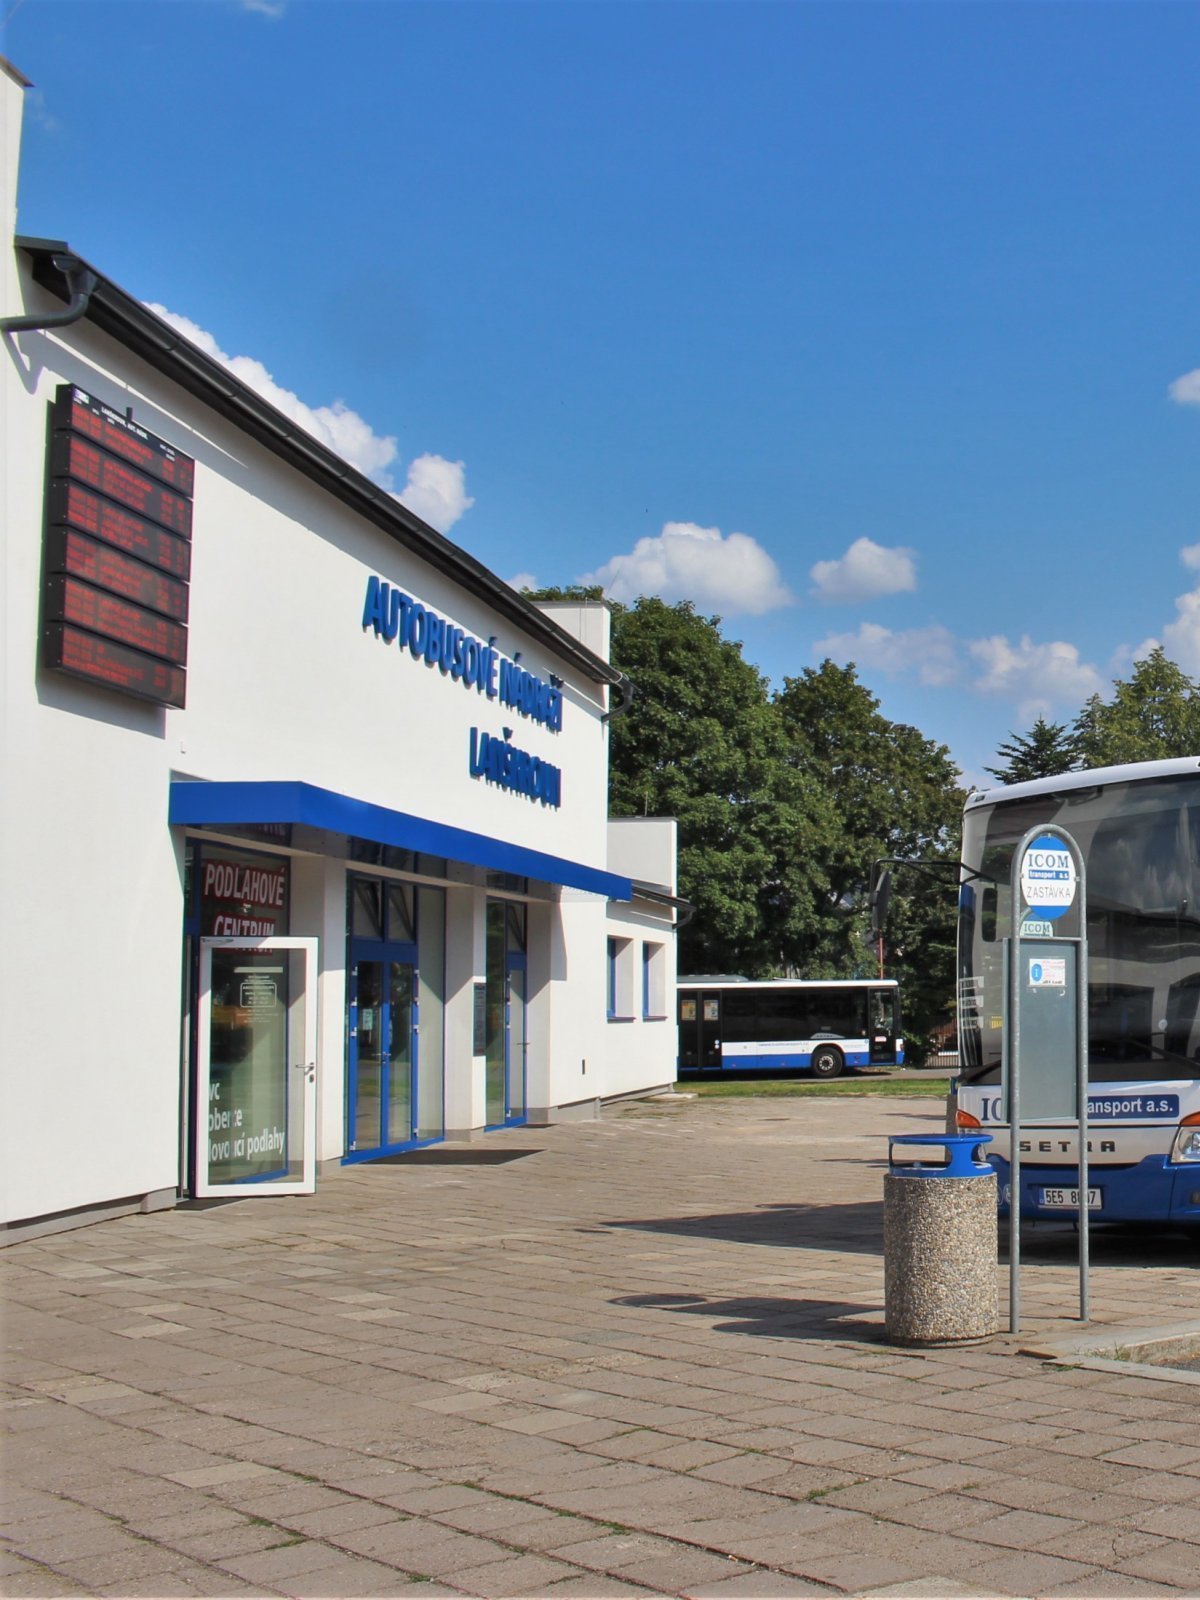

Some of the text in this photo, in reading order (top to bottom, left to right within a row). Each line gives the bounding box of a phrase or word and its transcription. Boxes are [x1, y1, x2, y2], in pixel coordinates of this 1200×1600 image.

[362, 576, 564, 734] AUTOBUSOVÉ NÁDRAŽÍ
[470, 727, 562, 810] LANŠKROUN
[1028, 854, 1069, 868] ICOM
[1029, 870, 1056, 879] transport
[205, 864, 285, 905] PODLAHOVÉ
[1026, 885, 1071, 898] ZASTÁVKA
[1024, 923, 1050, 934] ICOM
[1087, 1098, 1142, 1116] ansport
[1146, 1100, 1173, 1112] a.s.
[247, 1126, 285, 1160] podlahy
[1045, 1190, 1064, 1204] 5E5
